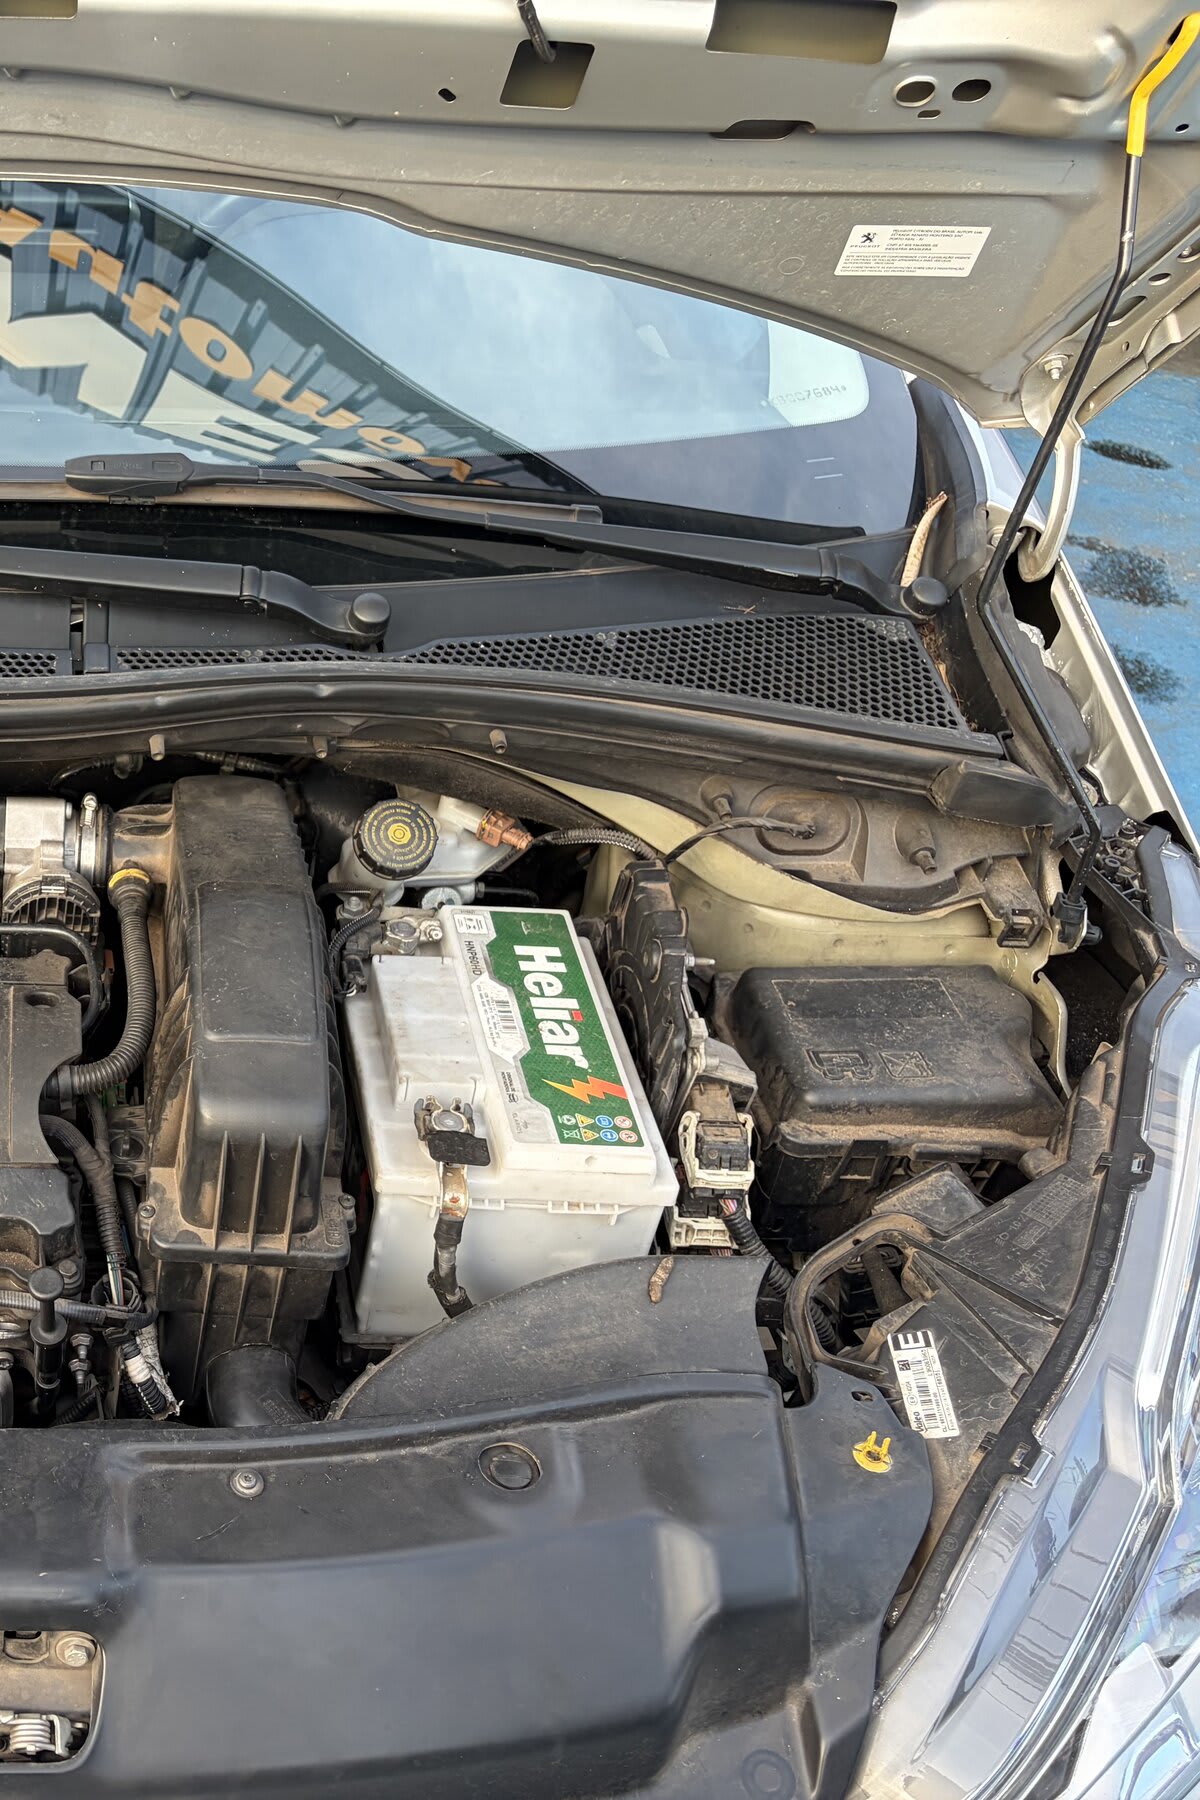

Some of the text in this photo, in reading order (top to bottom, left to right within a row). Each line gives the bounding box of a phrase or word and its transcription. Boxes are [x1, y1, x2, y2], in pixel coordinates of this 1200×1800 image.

[464, 940, 482, 976] HNP60HD
[513, 944, 589, 1069] Heliar
[898, 1331, 925, 1350] E
[913, 1411, 924, 1432] Valeo
